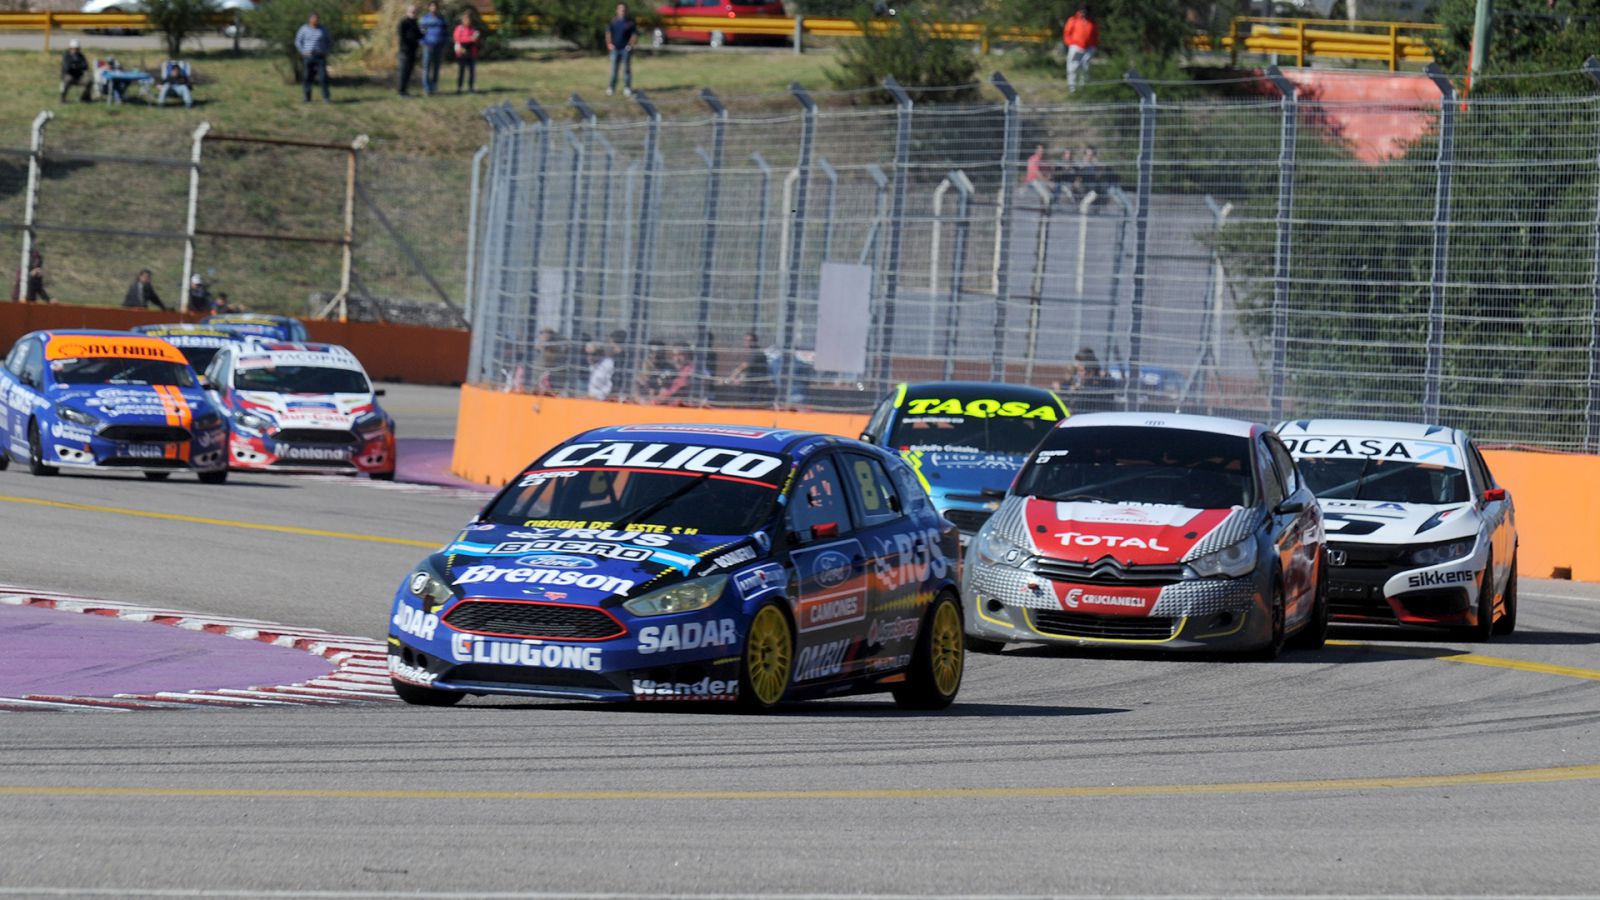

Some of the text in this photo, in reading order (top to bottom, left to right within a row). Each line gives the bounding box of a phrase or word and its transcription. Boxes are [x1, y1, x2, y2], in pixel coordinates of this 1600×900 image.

[908, 398, 1058, 421] TAQSA
[543, 442, 782, 479] CALICO
[853, 460, 881, 510] 8
[557, 527, 673, 547] RUS
[1054, 531, 1170, 552] TOTAL
[488, 540, 654, 562] BOERO
[894, 527, 948, 588] RUS
[452, 564, 635, 597] Brenson
[1408, 569, 1474, 588] sikkens
[810, 596, 858, 623] CAMIONES
[637, 617, 737, 655] SADAR
[793, 638, 850, 682] OMBU
[631, 678, 739, 696] Wander
